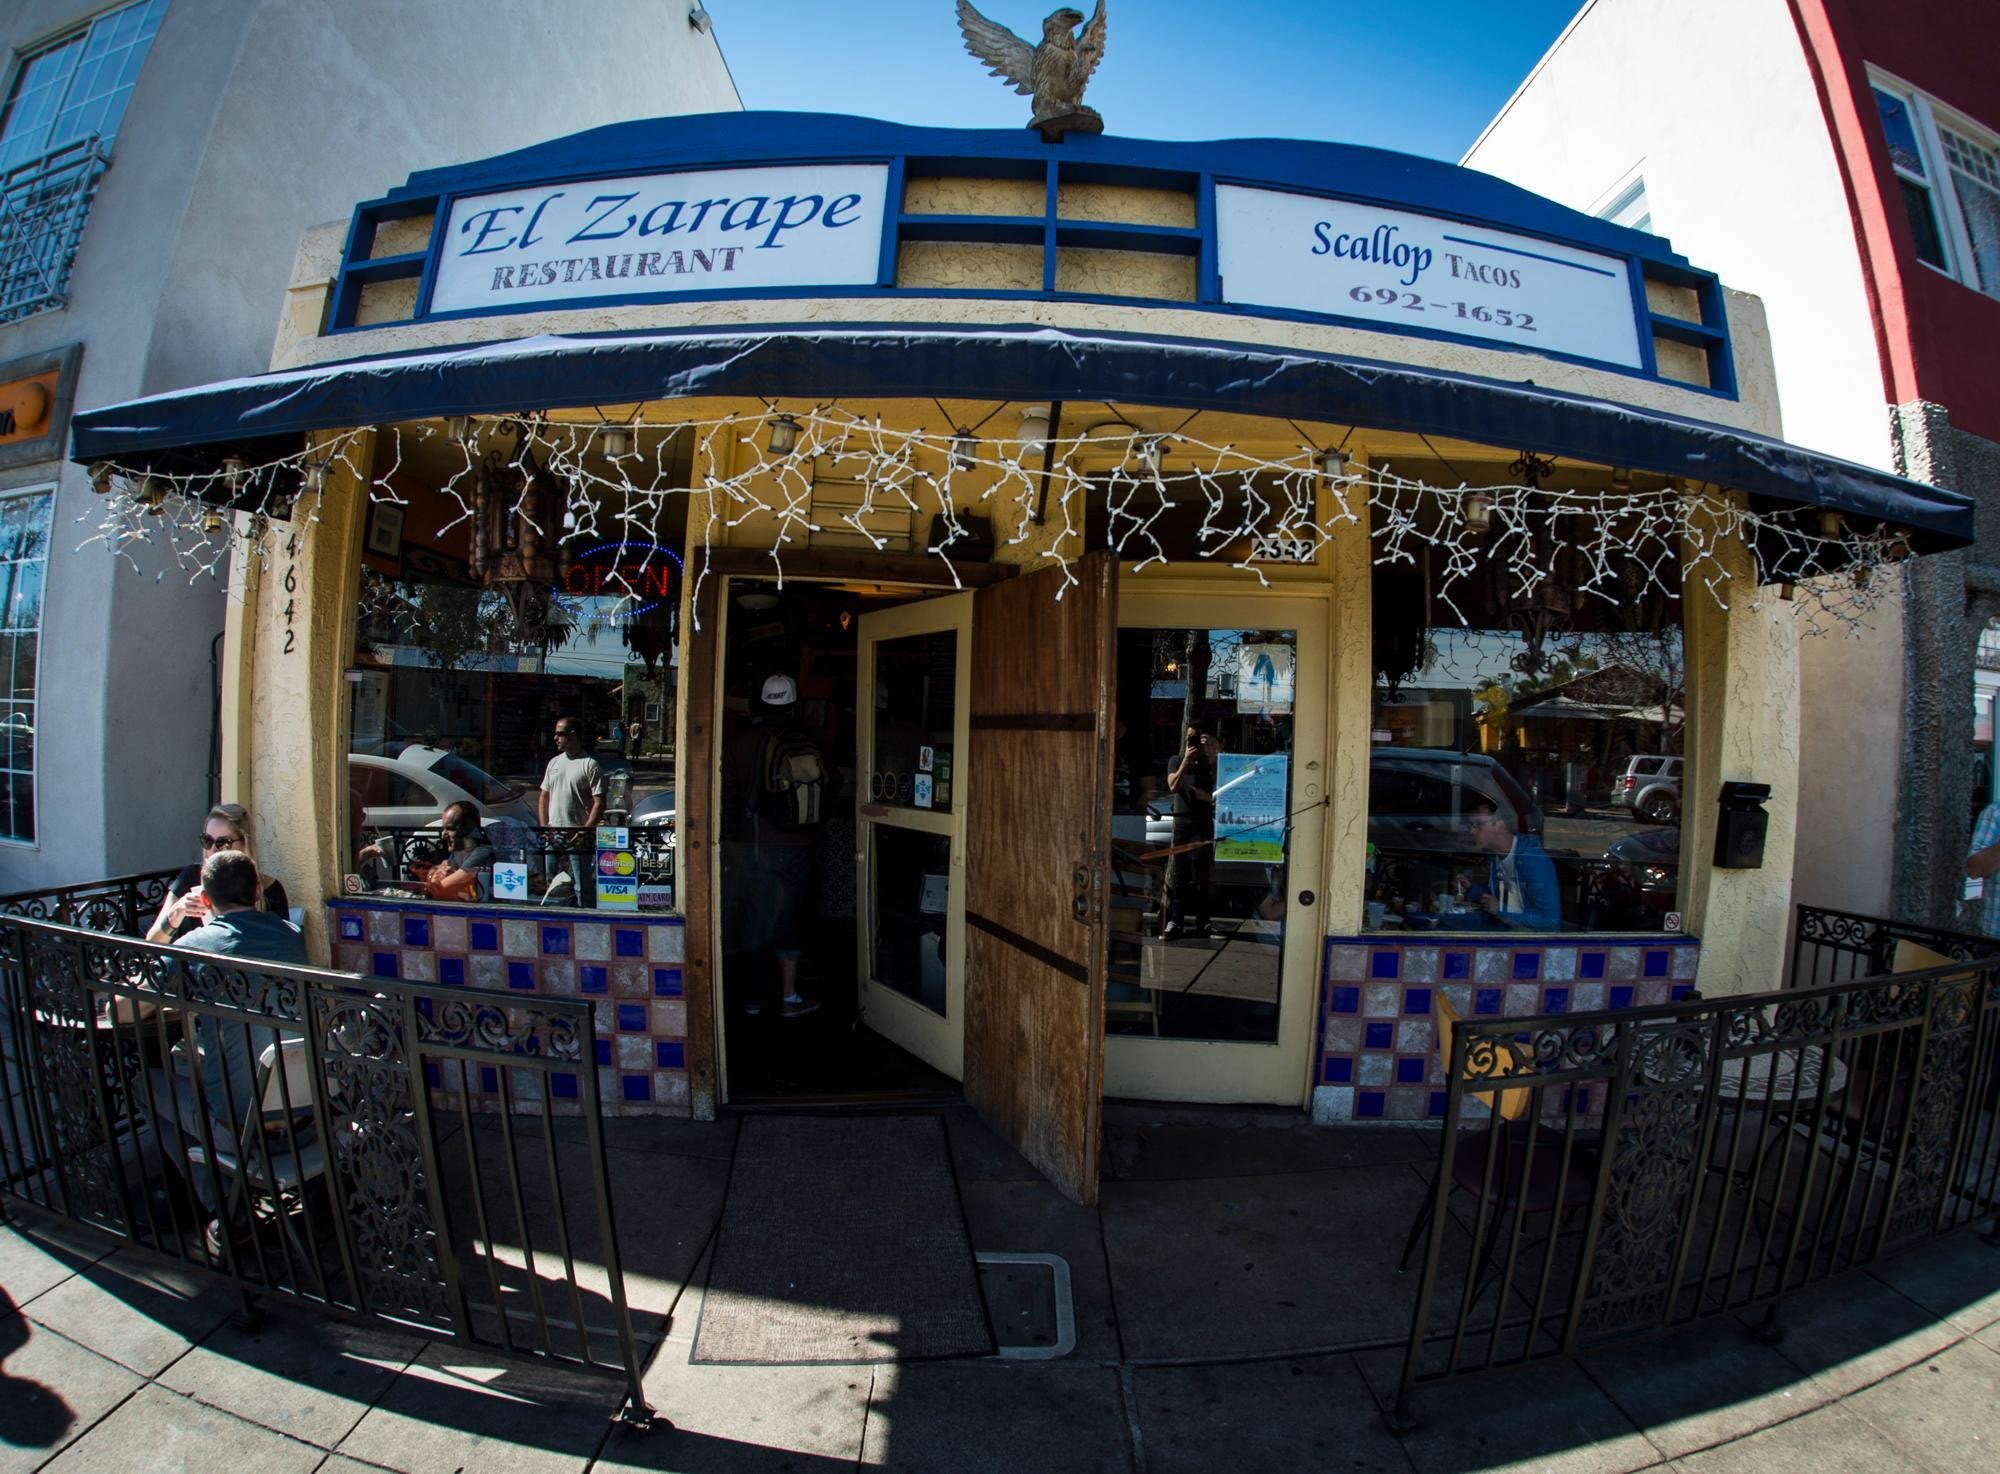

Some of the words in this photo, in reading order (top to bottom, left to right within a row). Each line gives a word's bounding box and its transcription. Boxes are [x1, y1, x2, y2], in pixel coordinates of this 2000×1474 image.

[459, 191, 565, 257] El
[565, 190, 863, 250] Zarape
[489, 246, 744, 291] RESTAURANT
[1311, 221, 1432, 286] Scallop
[1348, 285, 1538, 332] 692-1652
[564, 564, 669, 597] OPEN
[494, 874, 526, 887] BEST
[605, 885, 628, 895] VISA
